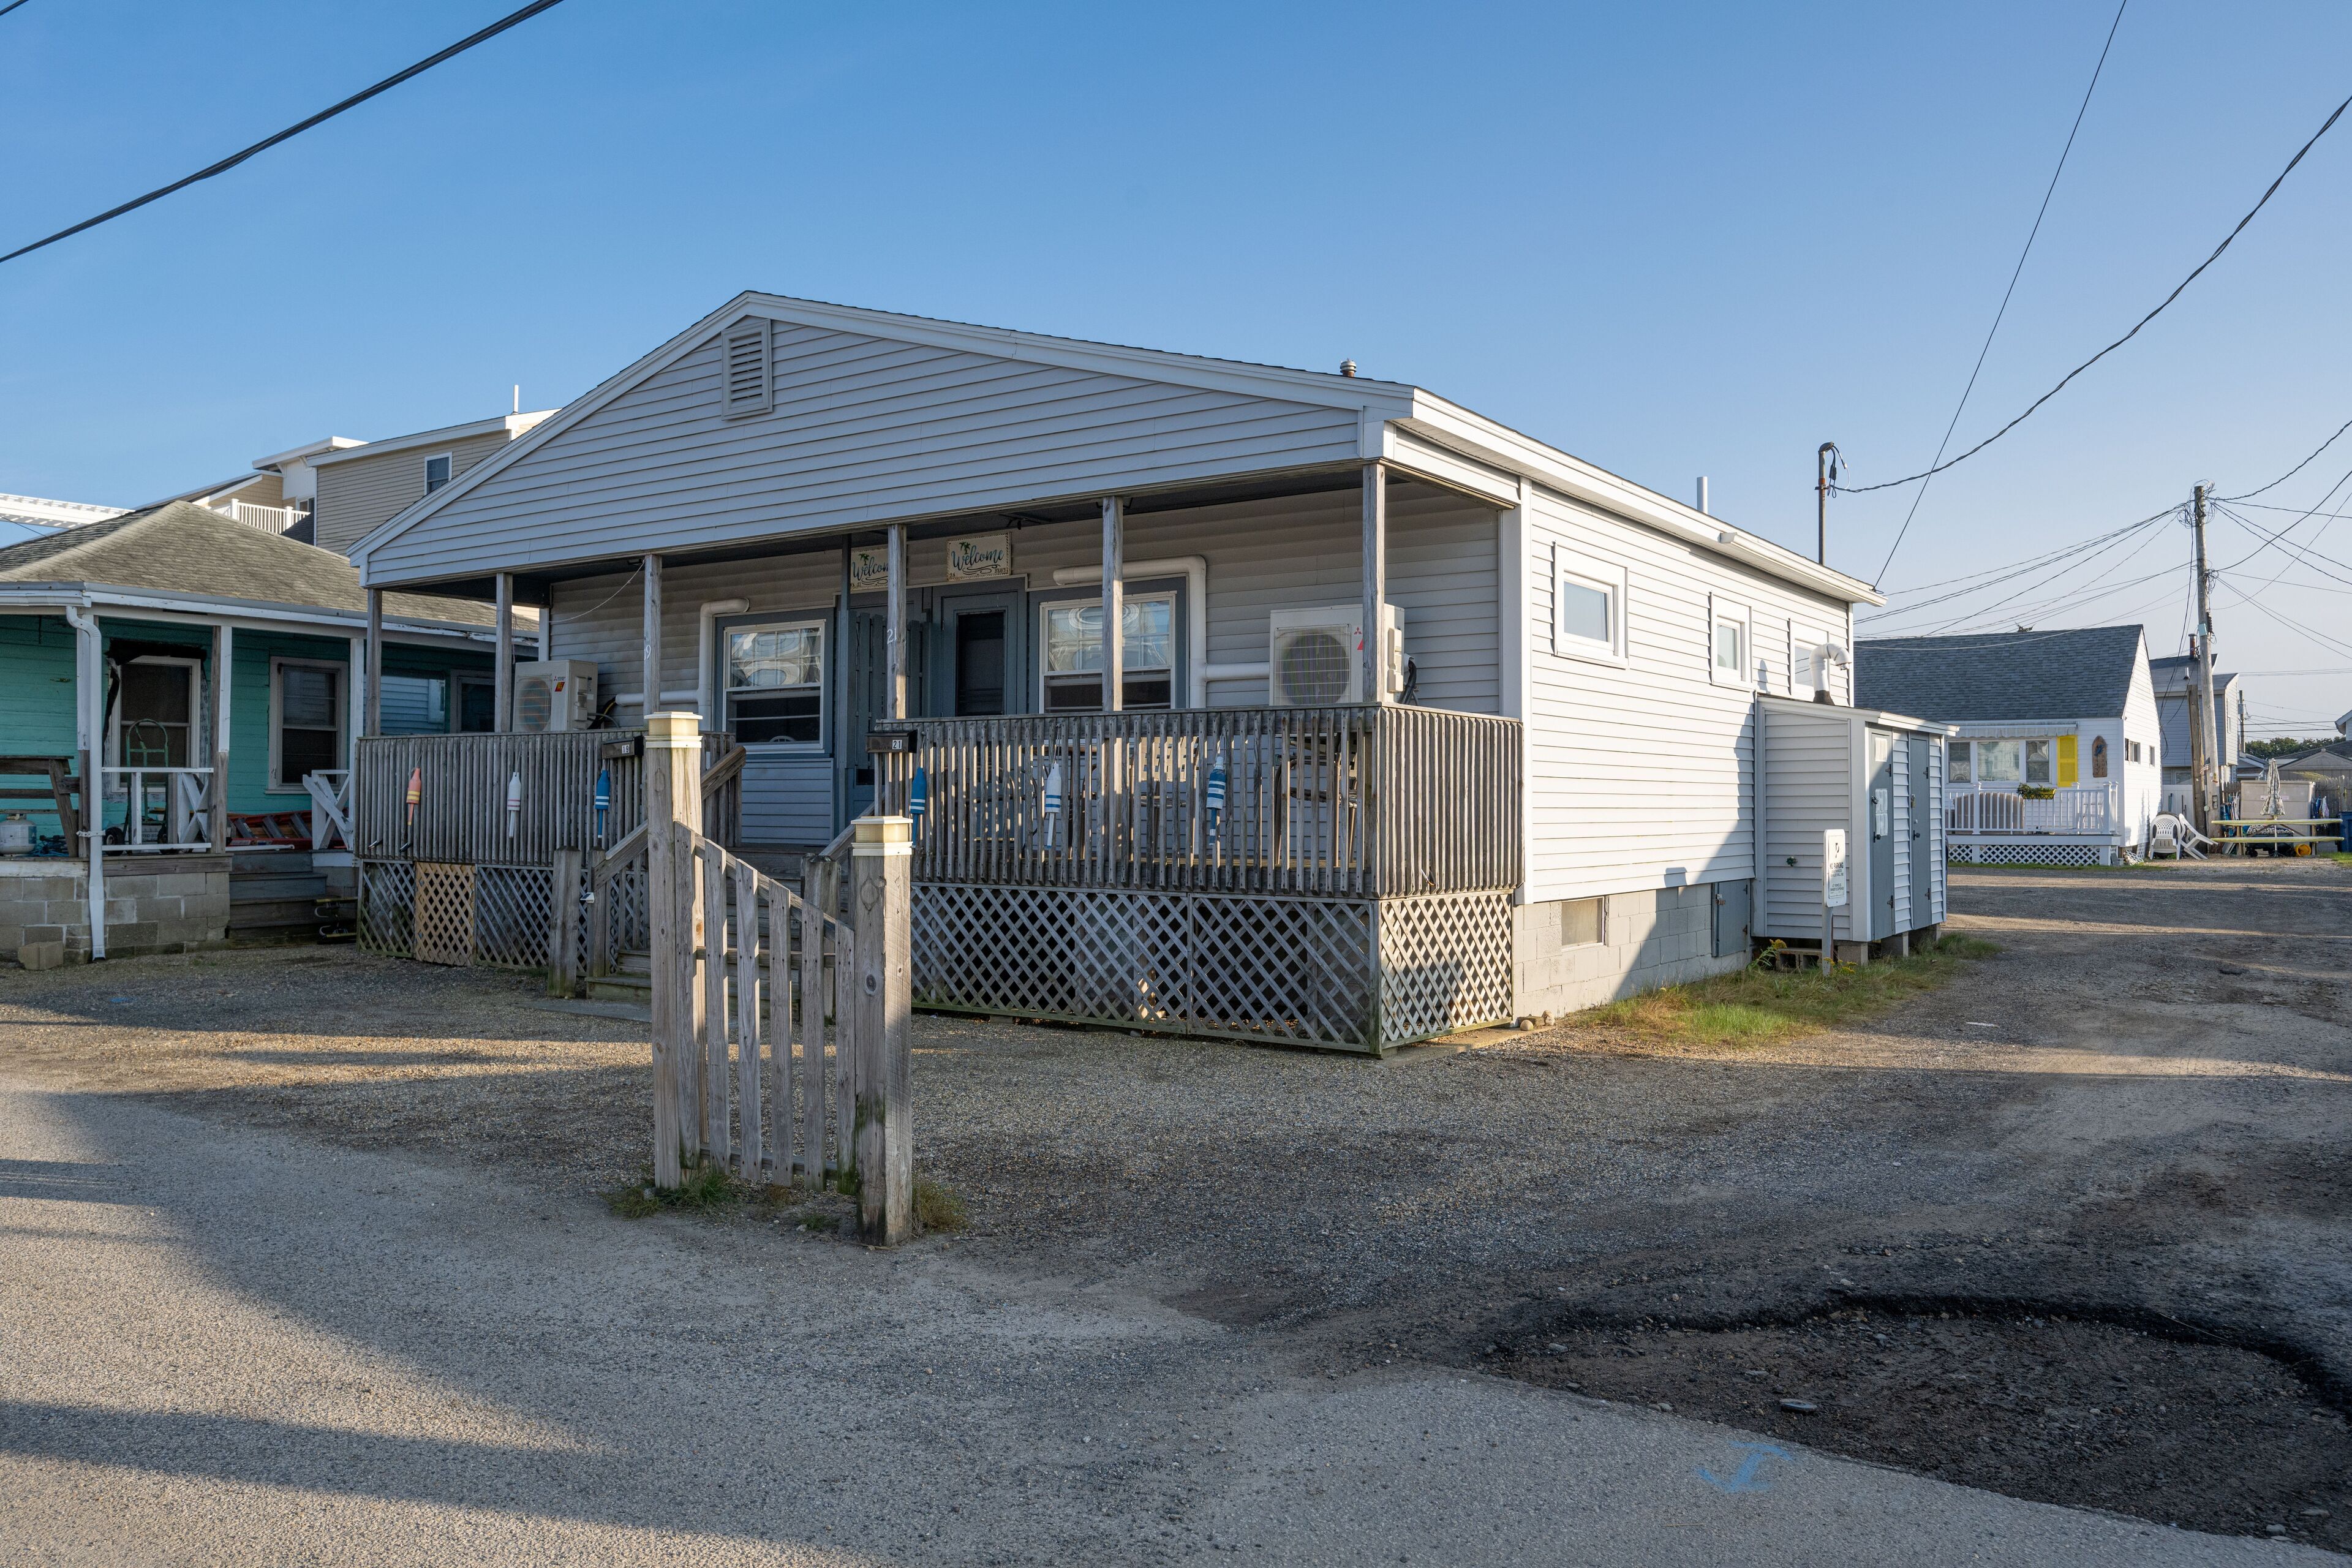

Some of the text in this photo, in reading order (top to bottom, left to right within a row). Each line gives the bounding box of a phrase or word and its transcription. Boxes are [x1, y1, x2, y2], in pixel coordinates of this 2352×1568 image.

[951, 545, 1005, 570] Welcome
[852, 557, 888, 581] Welco
[887, 627, 897, 644] 21
[644, 644, 651, 660] 19
[893, 741, 901, 749] 21
